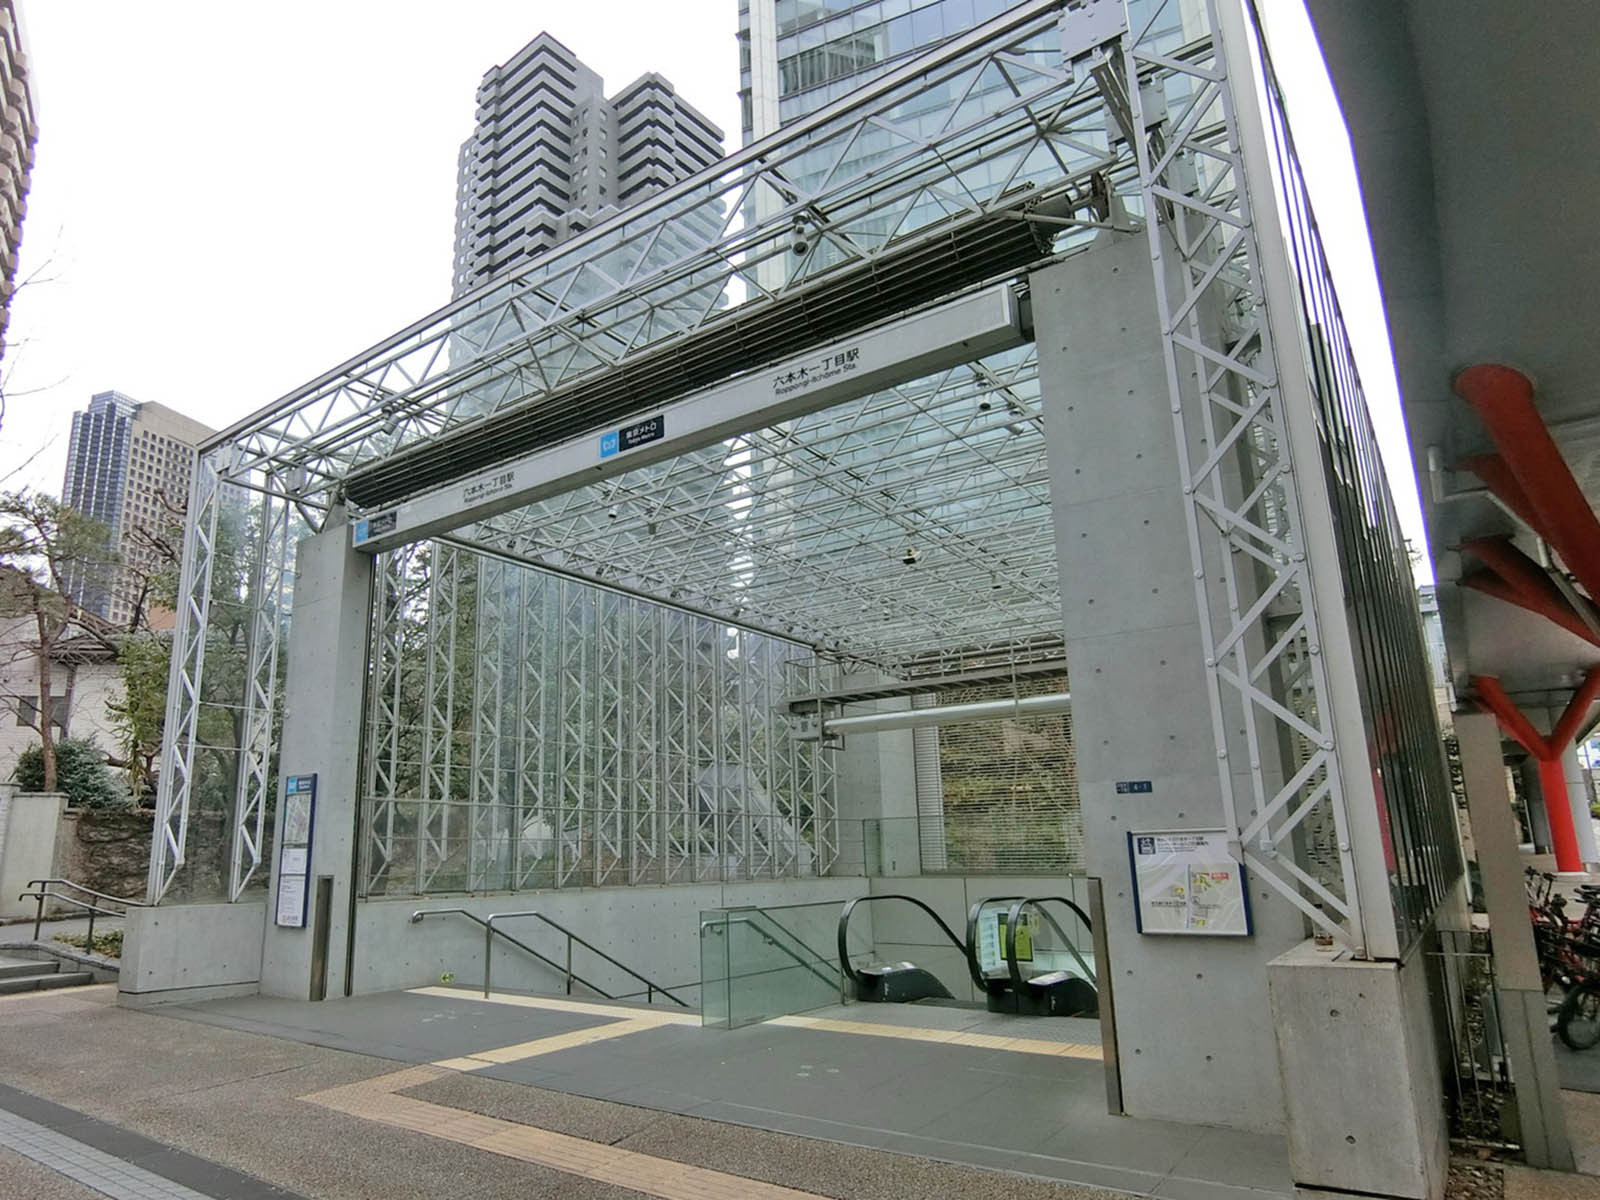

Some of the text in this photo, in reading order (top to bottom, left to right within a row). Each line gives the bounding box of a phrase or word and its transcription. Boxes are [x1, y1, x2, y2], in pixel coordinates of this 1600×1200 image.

[772, 347, 860, 389] 六本木一丁目駅
